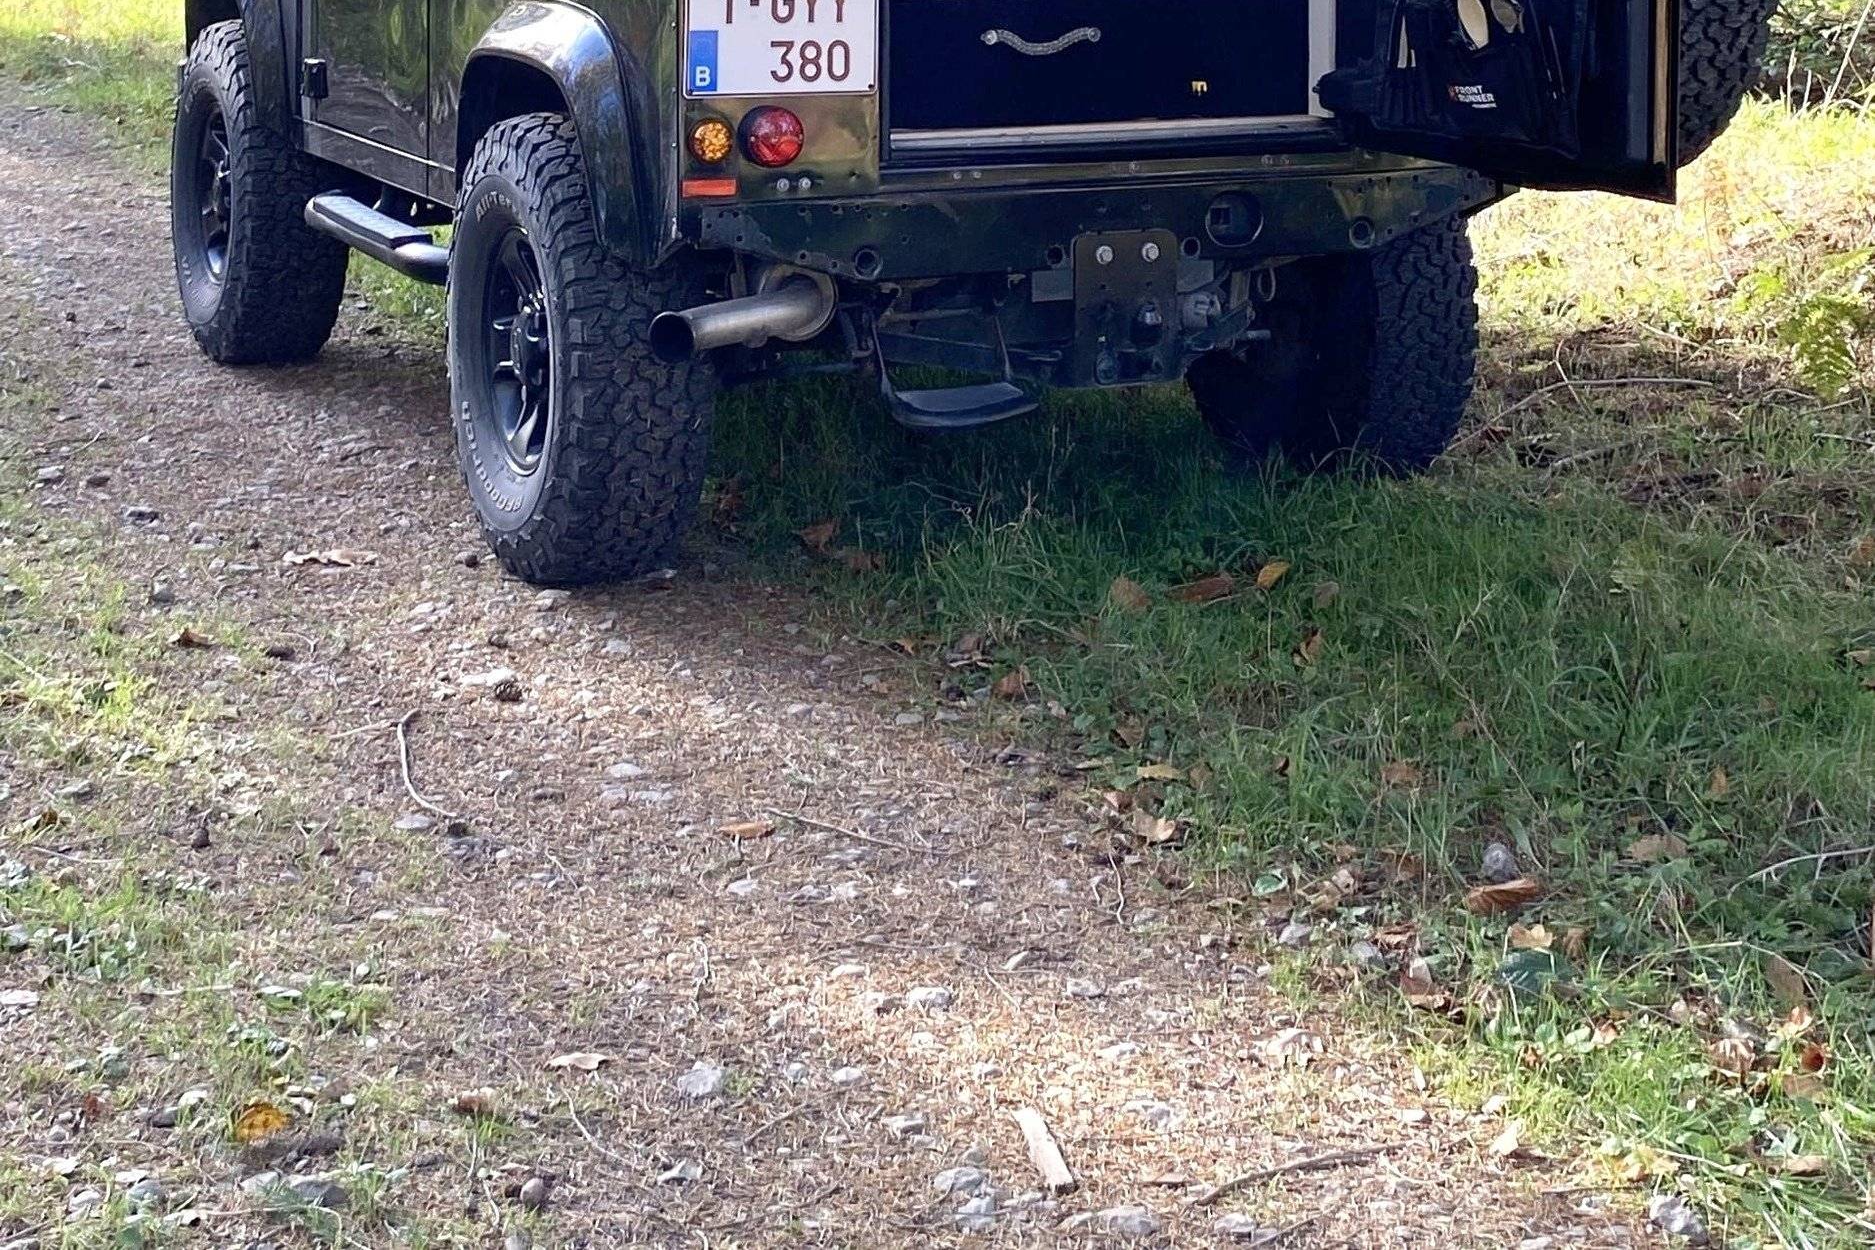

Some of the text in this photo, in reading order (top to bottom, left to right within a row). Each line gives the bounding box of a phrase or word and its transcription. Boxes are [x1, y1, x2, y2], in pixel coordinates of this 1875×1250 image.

[770, 39, 851, 83] 380
[695, 66, 711, 86] B
[1454, 85, 1482, 94] FRONT
[1457, 93, 1494, 102] RUNNER
